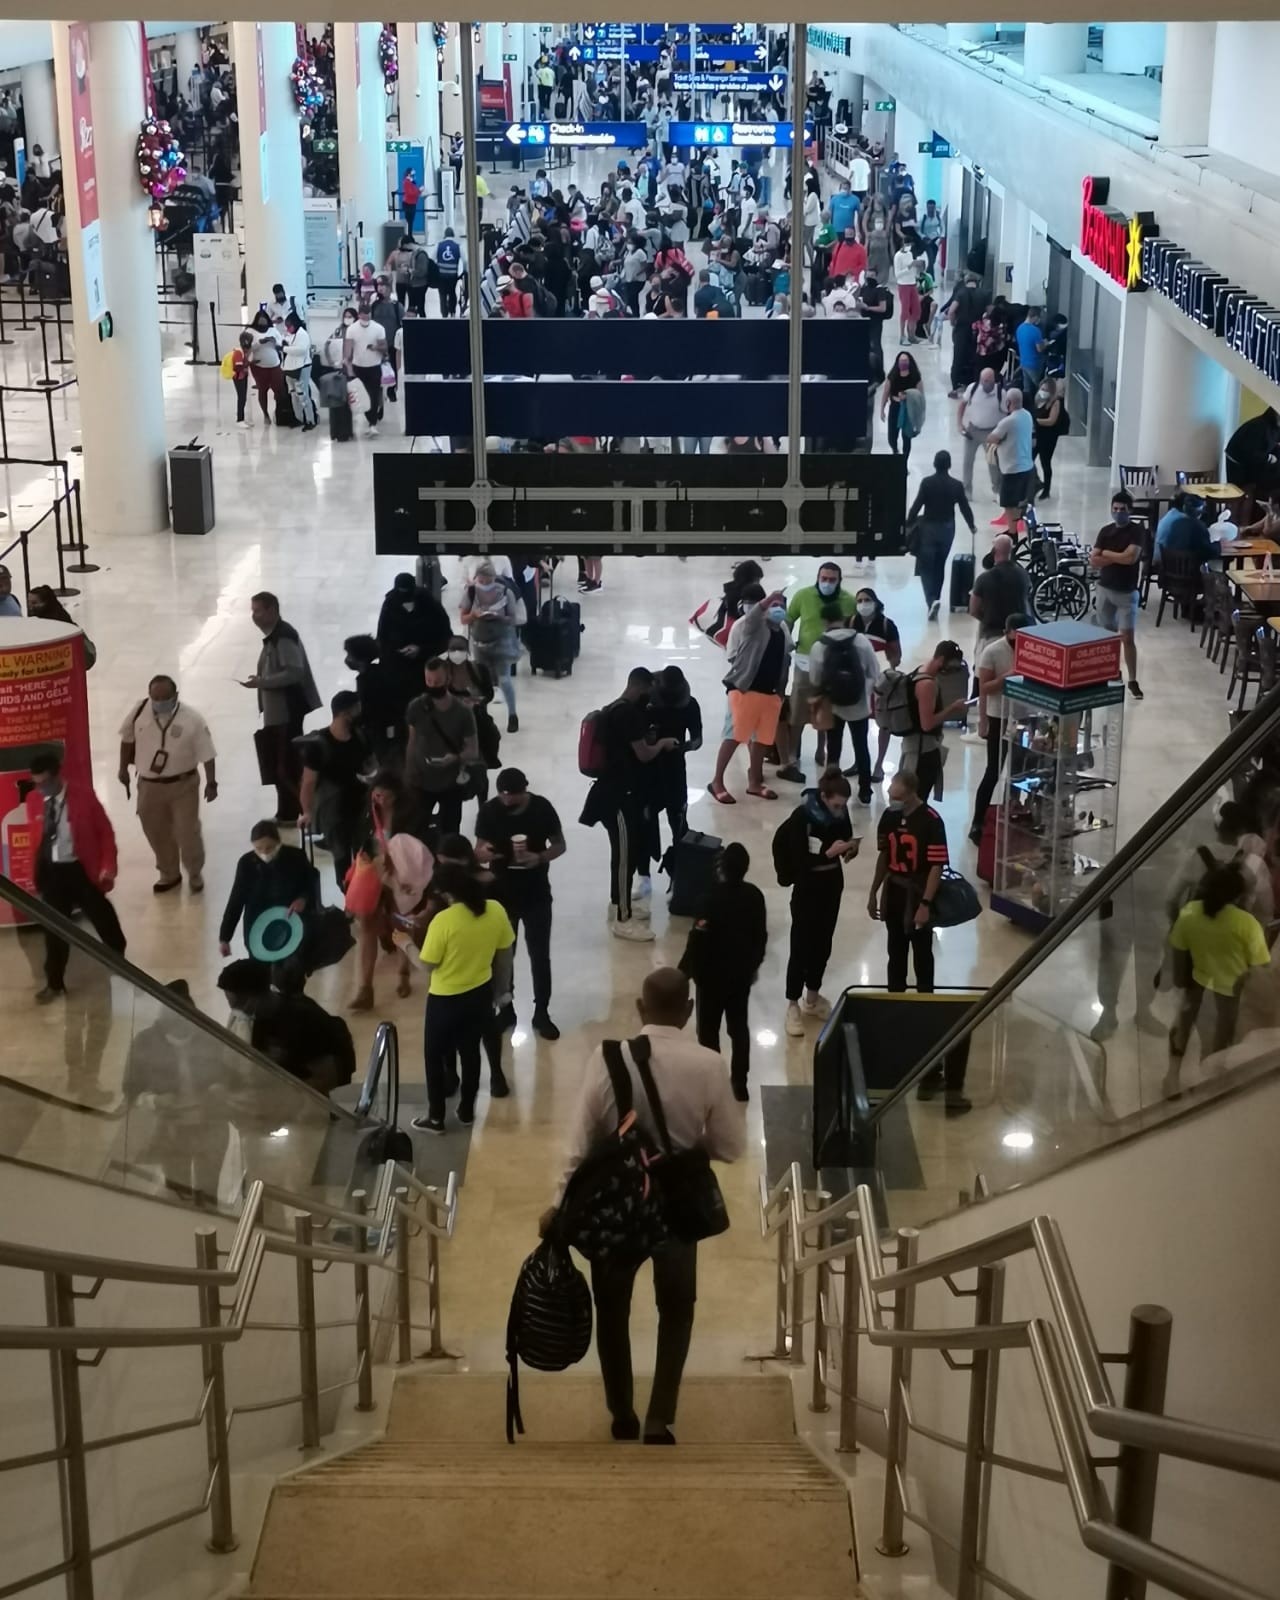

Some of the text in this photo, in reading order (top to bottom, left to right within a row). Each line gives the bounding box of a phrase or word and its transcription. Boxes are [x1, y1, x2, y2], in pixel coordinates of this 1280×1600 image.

[13, 646, 71, 666] WARNING
[1024, 640, 1057, 658] OBJETOS
[22, 691, 44, 703] AND
[46, 686, 69, 699] GELS
